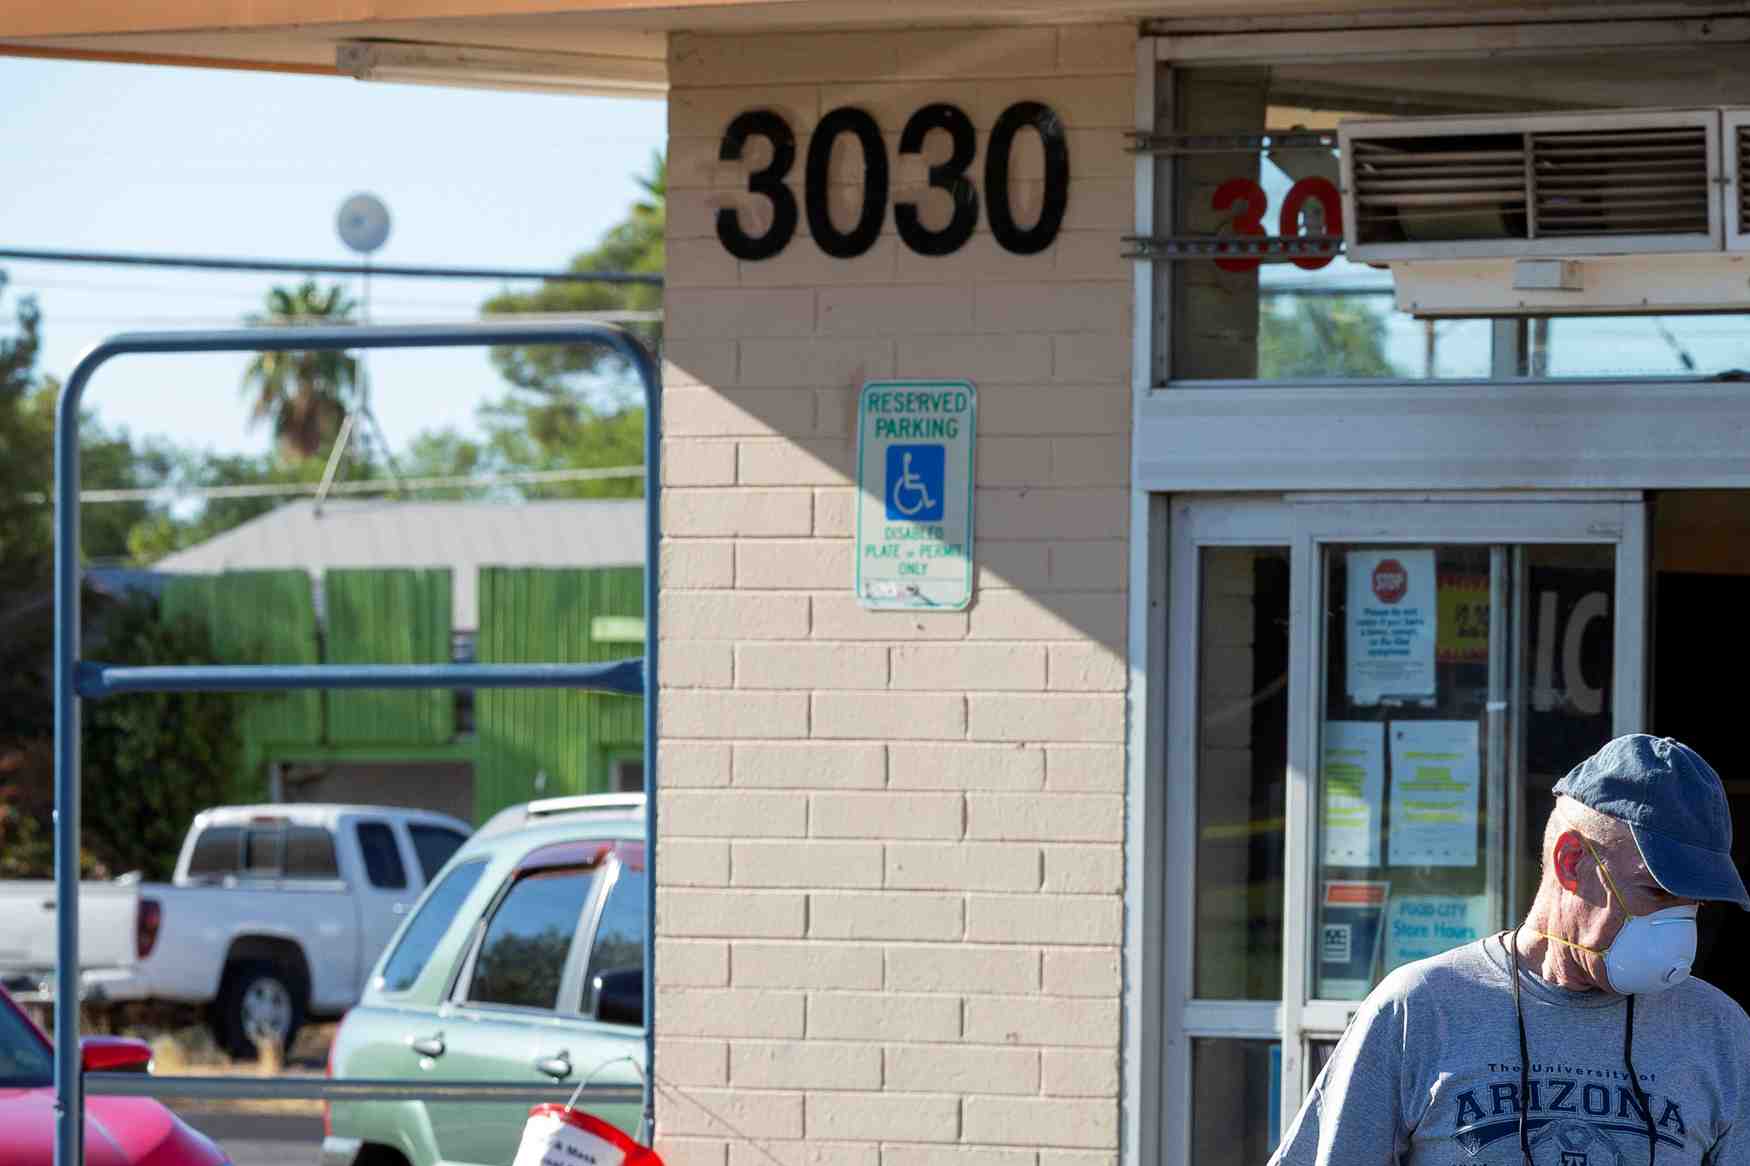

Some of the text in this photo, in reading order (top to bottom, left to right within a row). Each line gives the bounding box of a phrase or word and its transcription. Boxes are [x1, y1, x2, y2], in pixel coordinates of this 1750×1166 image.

[716, 101, 1069, 261] 3030
[867, 392, 967, 414] RESERVED
[875, 417, 959, 439] PARKING
[884, 526, 945, 540] DISABLED
[865, 543, 901, 558] PLATE
[919, 543, 963, 557] PERMIT
[898, 562, 929, 575] ONLY
[1375, 572, 1404, 592] STOP
[1437, 903, 1467, 917] CITY
[1394, 919, 1476, 939] Store Hours
[1487, 1063, 1656, 1082] The University of
[1455, 1079, 1686, 1135] ARIZONA
[567, 1144, 597, 1165] Mask
